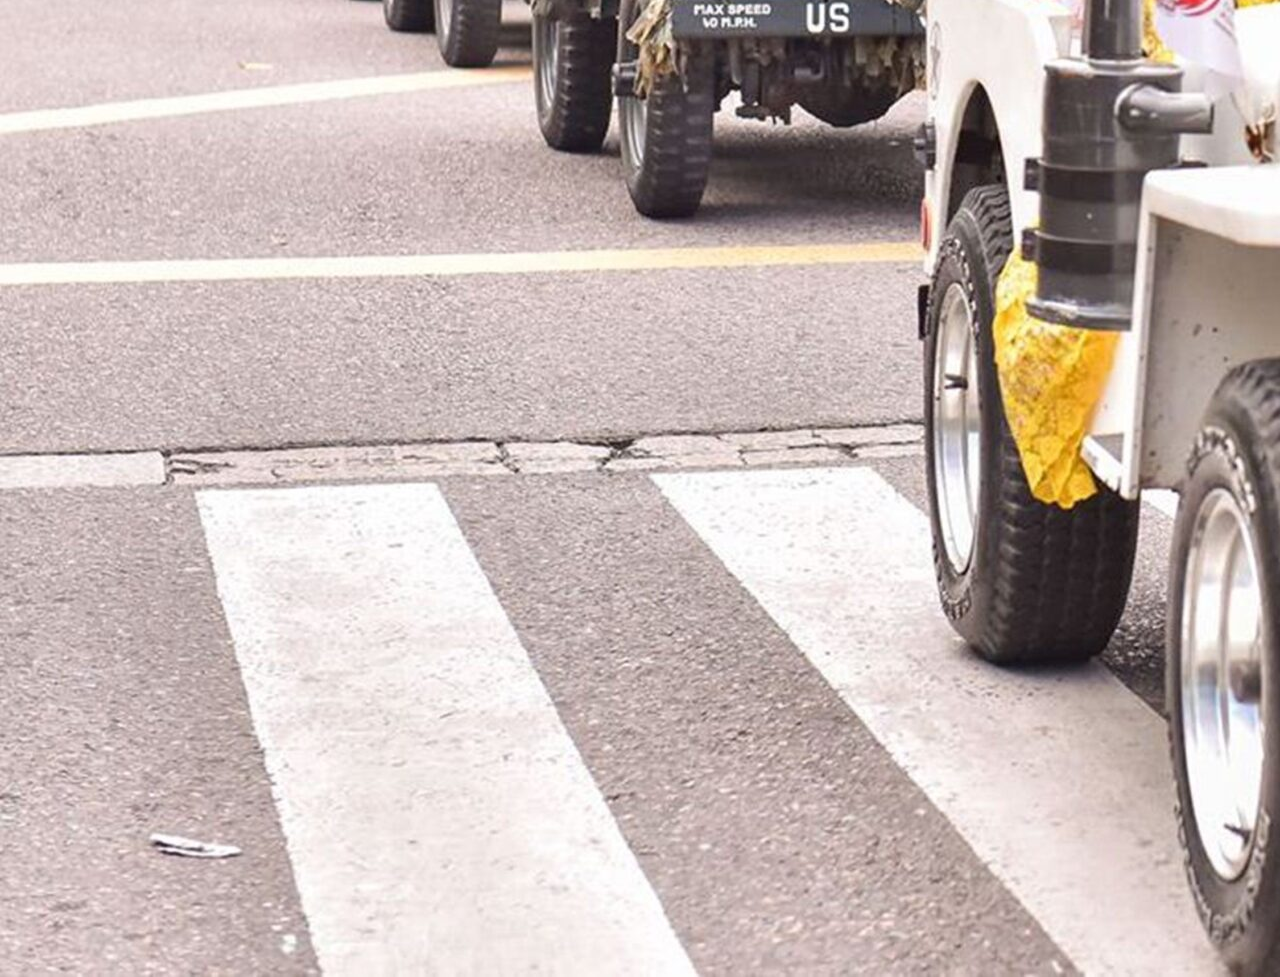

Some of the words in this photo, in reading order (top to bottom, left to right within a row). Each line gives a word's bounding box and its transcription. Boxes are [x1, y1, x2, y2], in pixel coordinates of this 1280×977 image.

[693, 3, 725, 16] MAX
[727, 3, 772, 16] SPEED
[806, 2, 850, 34] US
